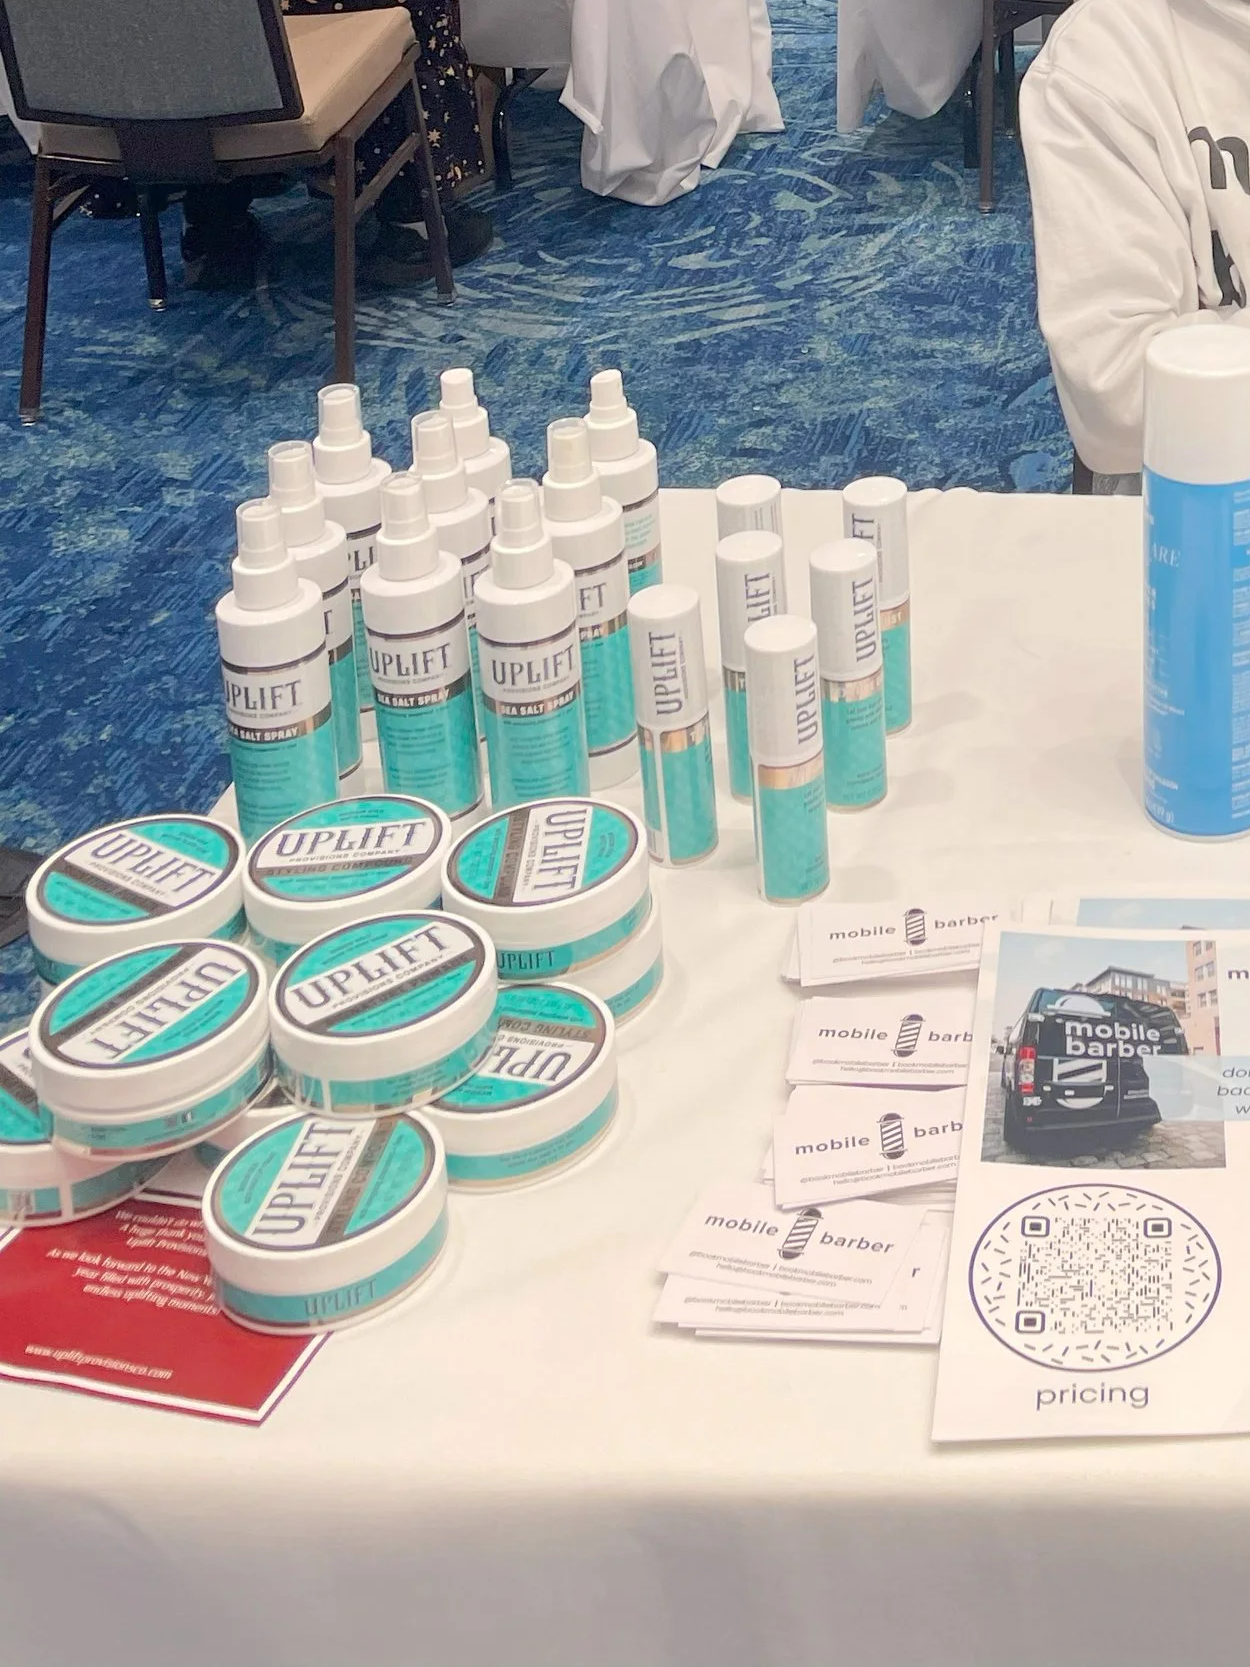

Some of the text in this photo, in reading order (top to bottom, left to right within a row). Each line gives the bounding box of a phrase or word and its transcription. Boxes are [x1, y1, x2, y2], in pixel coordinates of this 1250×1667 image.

[744, 572, 771, 623] LIFT
[852, 577, 877, 663] UPLIFT
[369, 641, 451, 677] UPLIFT
[491, 644, 574, 686] UPLIFT
[649, 631, 683, 716] UPLIFT
[392, 696, 414, 707] SALT
[519, 703, 545, 716] SALT
[793, 653, 819, 745] UPLIFT
[276, 821, 426, 858] UPLIFT
[533, 808, 588, 891] UPLIFT
[91, 833, 215, 893] UPLIFT
[829, 914, 999, 940] mobile barber
[290, 925, 448, 1009] UPLIFT
[496, 949, 555, 971] UPLIFT
[91, 960, 242, 1061] UPLIFT
[818, 1028, 973, 1043] mobile barb
[1065, 1020, 1161, 1042] mobile
[1065, 1036, 1162, 1058] barber
[491, 1045, 572, 1082] UPL
[795, 1120, 964, 1156] mobile barb
[252, 1121, 357, 1236] UPLIFT
[892, 1155, 960, 1171] bookmobilebarb
[704, 1213, 895, 1254] mobile barber
[46, 1248, 201, 1283] As we look forward to the New
[127, 1273, 152, 1286] with
[83, 1283, 123, 1299] endless
[123, 1285, 168, 1308] uplifting
[304, 1279, 378, 1317] UPLIFT
[24, 1344, 174, 1380] www.upliftprovisionsco.com
[1036, 1381, 1149, 1412] pricing
